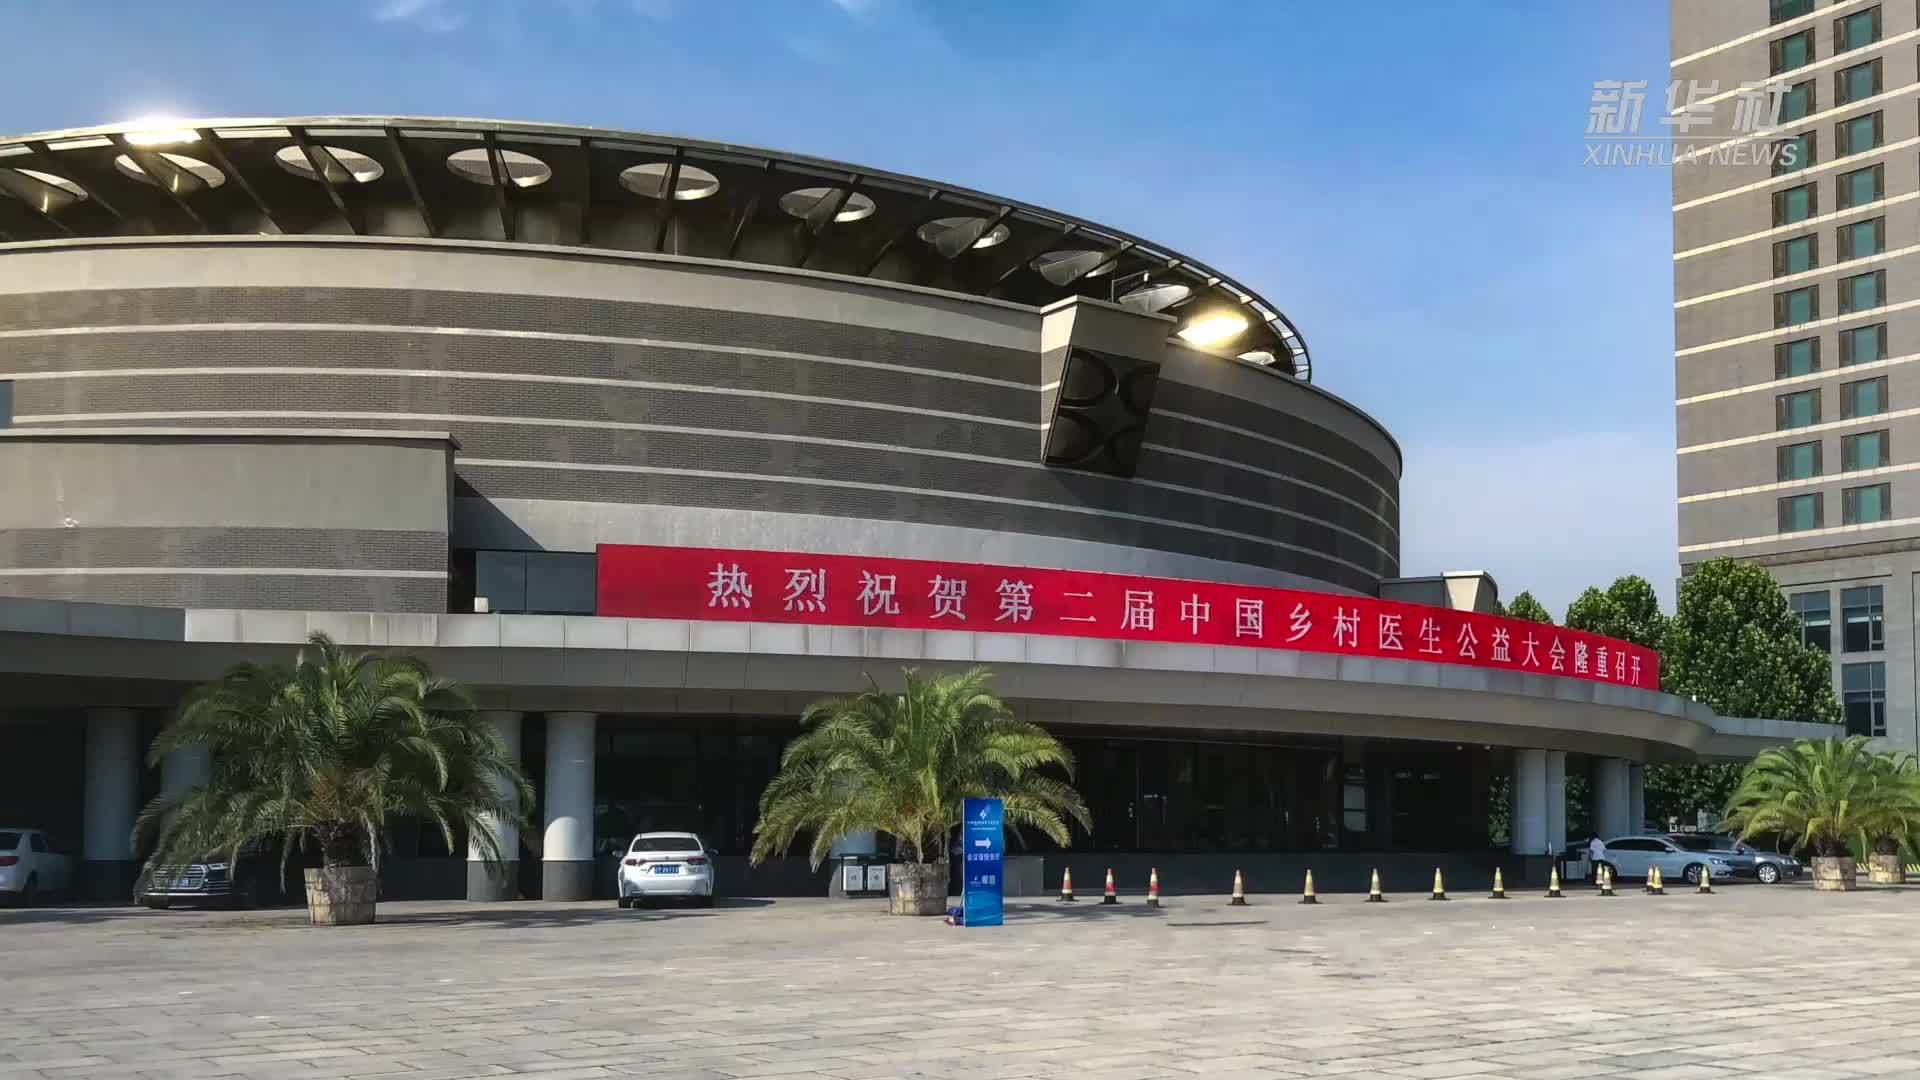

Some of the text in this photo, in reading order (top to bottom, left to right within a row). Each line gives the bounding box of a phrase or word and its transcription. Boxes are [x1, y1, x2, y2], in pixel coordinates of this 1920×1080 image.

[707, 562, 1642, 686] 热烈祝贺第二届中国乡村医生公益大会隆重召开
